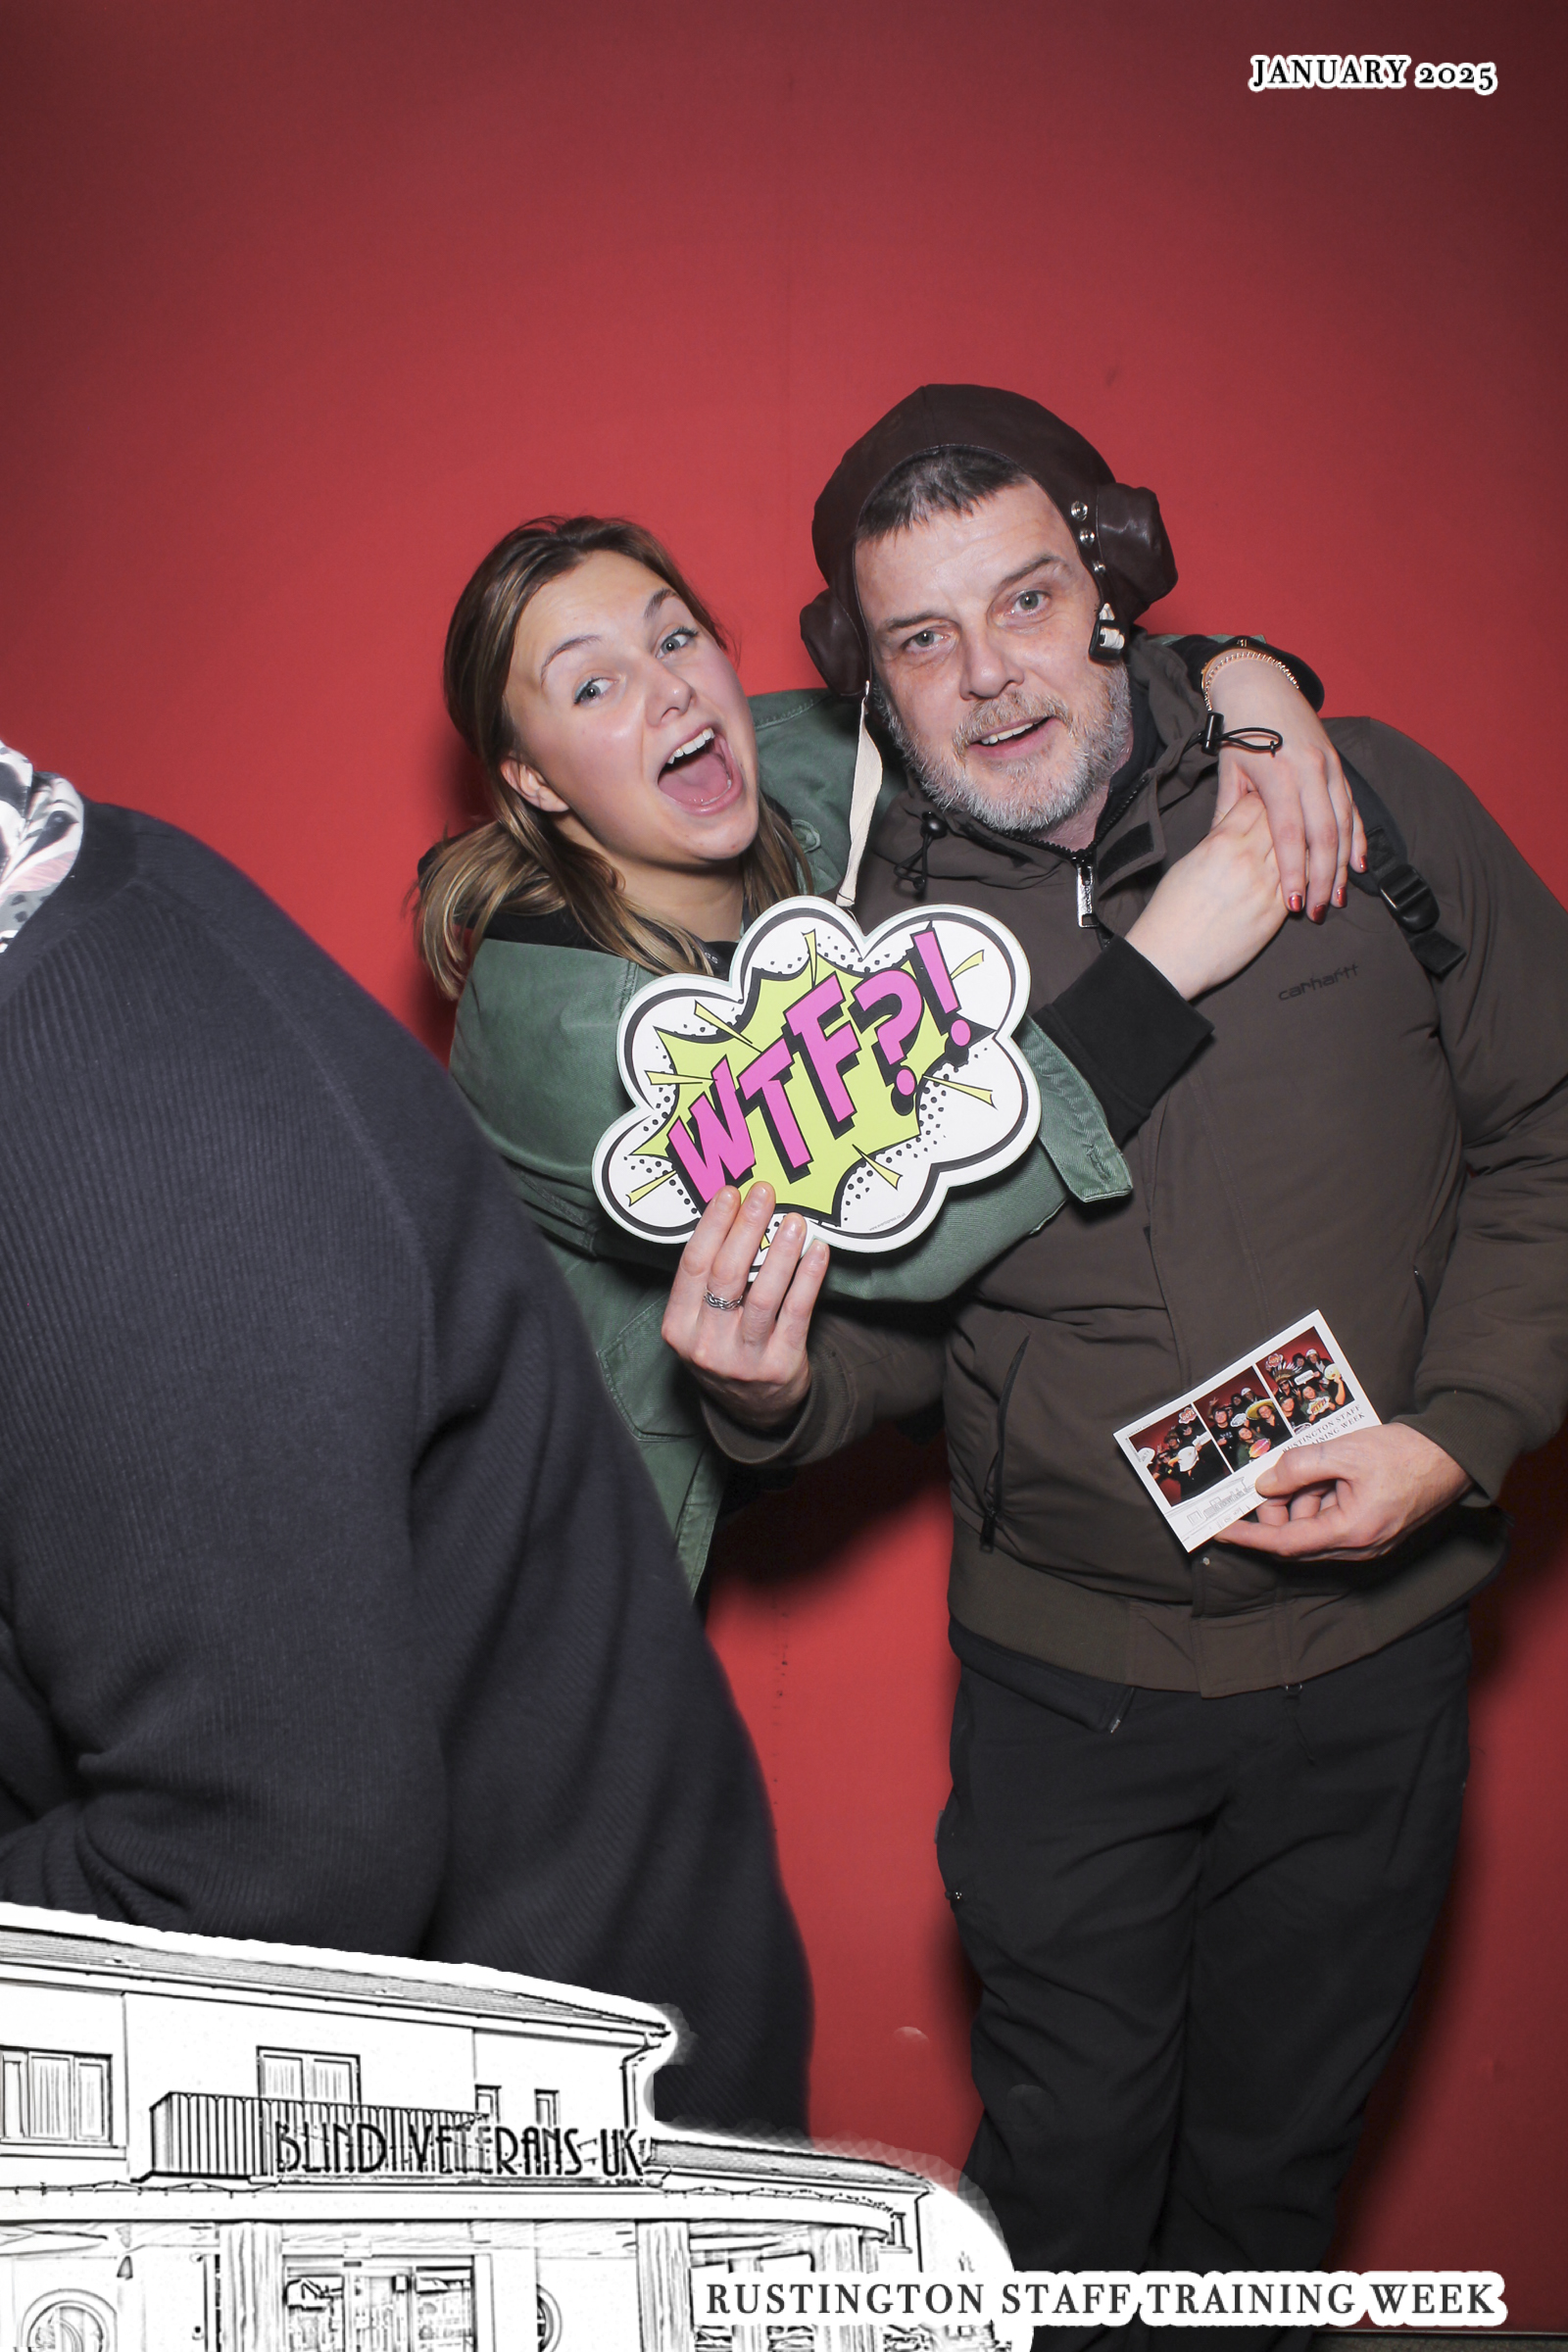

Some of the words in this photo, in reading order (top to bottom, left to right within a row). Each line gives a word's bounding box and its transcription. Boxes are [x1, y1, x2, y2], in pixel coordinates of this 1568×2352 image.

[1278, 963, 1359, 1001] carhartt
[666, 927, 973, 1205] WTF?!
[1335, 1404, 1361, 1423] STAFF
[1341, 1412, 1365, 1429] WEEK
